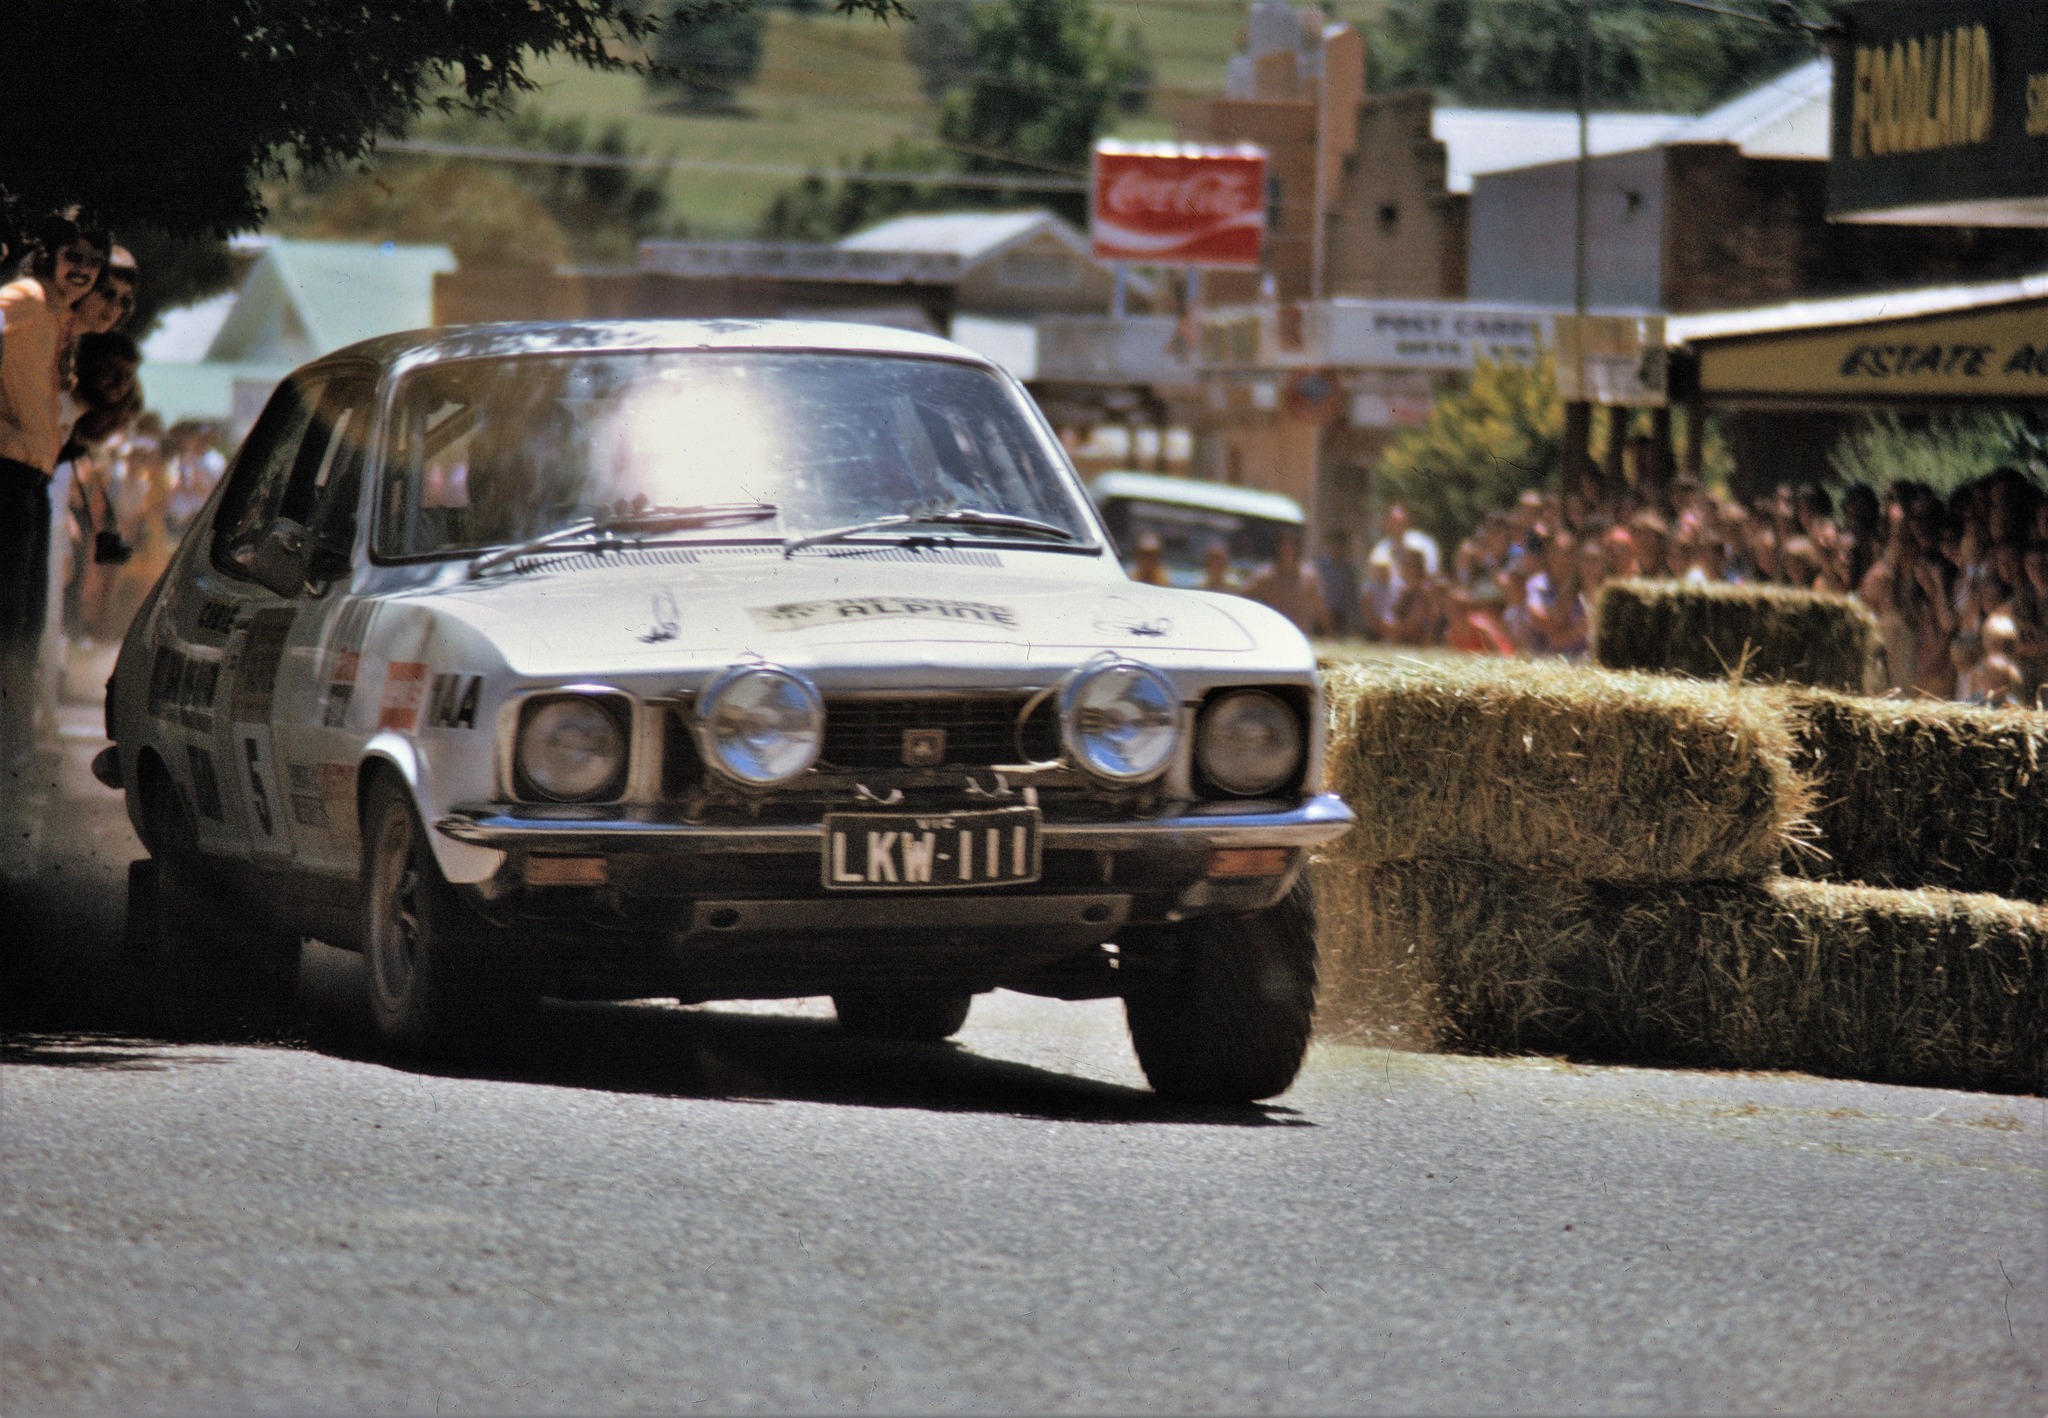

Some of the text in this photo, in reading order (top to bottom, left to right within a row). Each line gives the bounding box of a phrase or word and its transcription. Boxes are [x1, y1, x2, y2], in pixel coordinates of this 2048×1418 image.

[1455, 317, 1541, 337] CARD
[1838, 342, 1996, 378] ESTATE
[838, 603, 1019, 626] ALPINE
